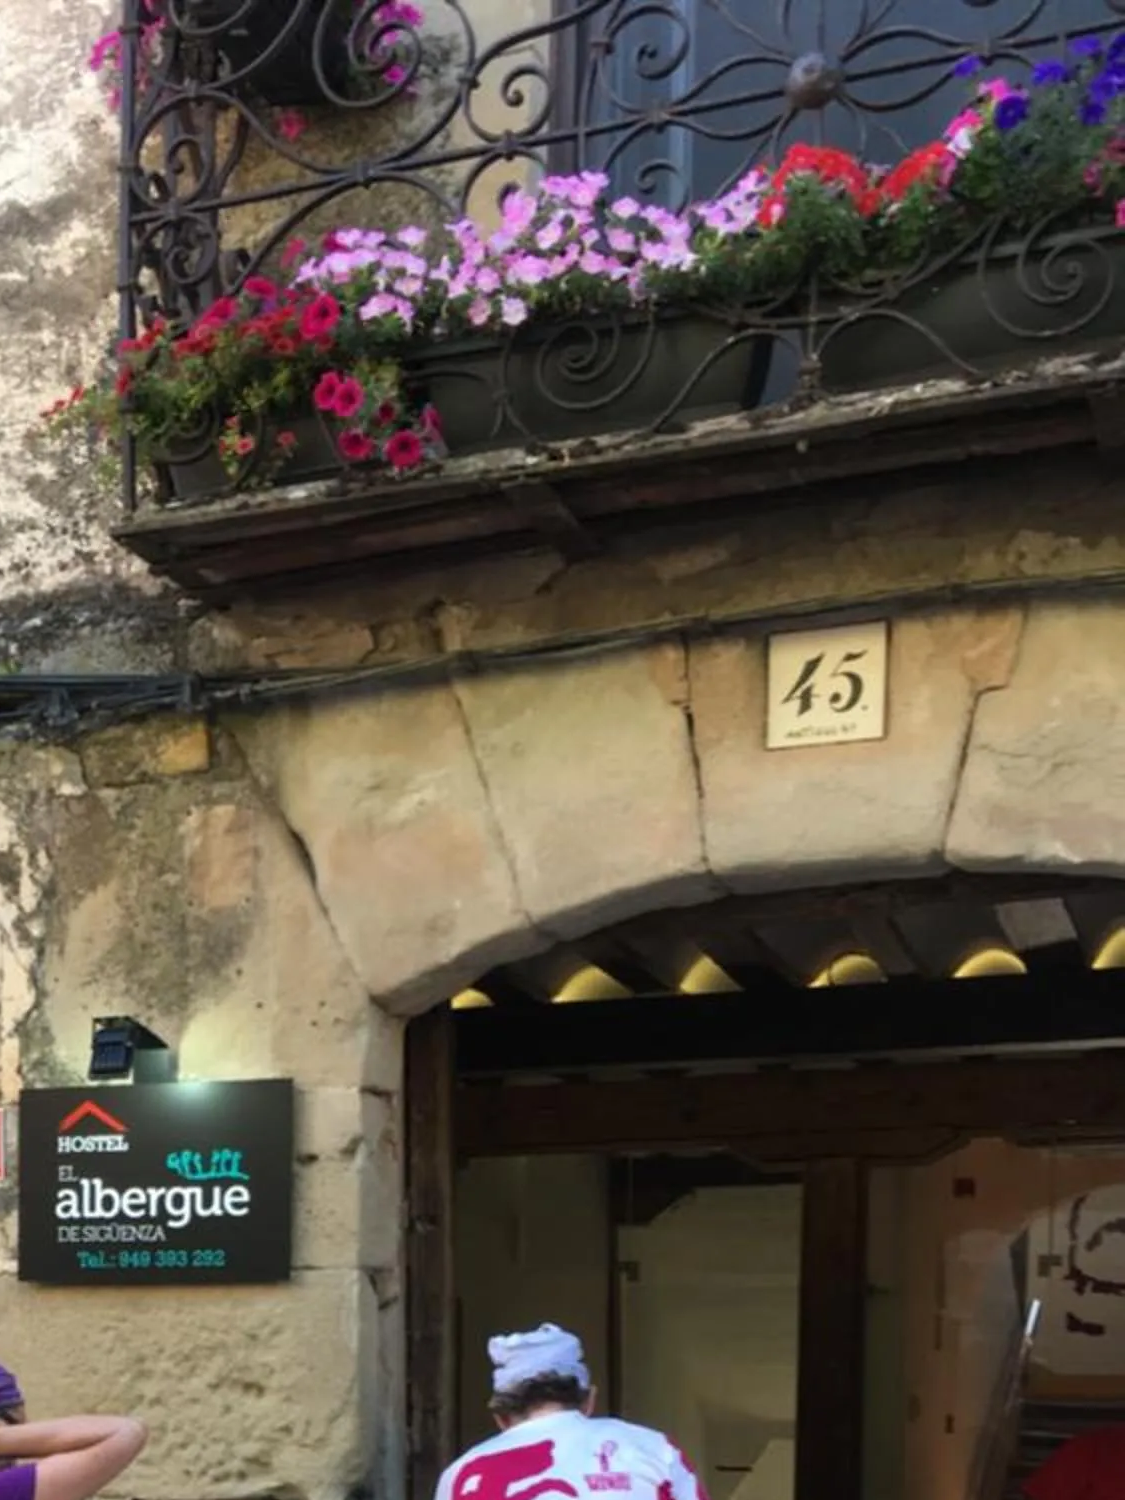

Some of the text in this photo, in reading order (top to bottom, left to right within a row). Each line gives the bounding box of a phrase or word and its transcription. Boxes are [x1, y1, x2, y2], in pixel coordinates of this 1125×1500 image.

[57, 1135, 129, 1153] HOSTEL
[58, 1165, 80, 1182] EL
[55, 1178, 251, 1228] albergue
[58, 1223, 167, 1243] DE SIGÜENZA
